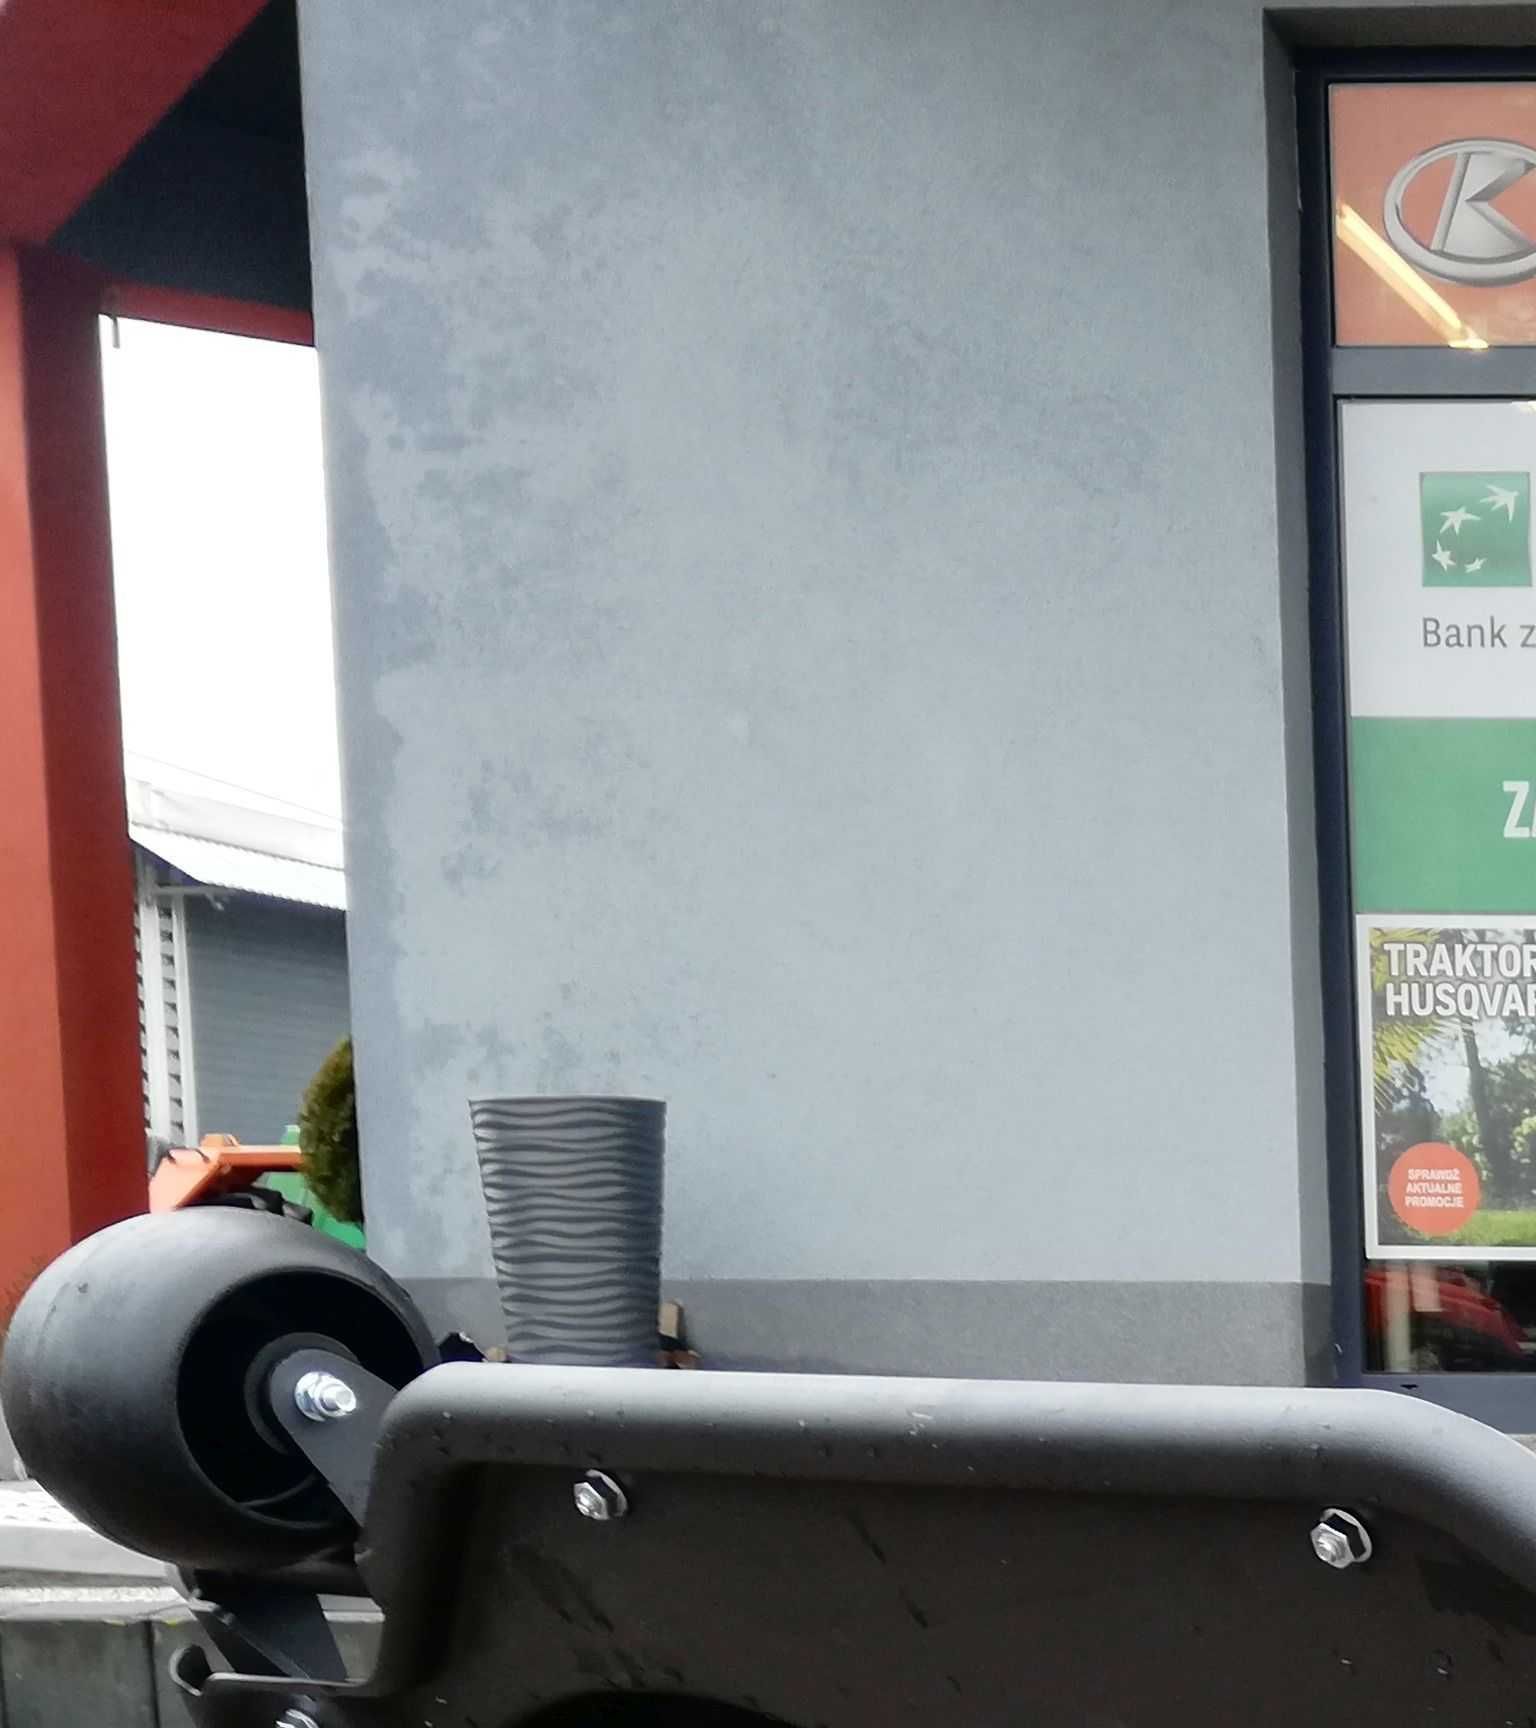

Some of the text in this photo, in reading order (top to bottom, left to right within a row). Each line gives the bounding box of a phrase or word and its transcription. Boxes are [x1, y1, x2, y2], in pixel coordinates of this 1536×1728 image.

[1421, 615, 1508, 650] Bank
[1406, 1182, 1463, 1194] AKTUALNE
[1404, 1196, 1464, 1208] PROMOCJE
